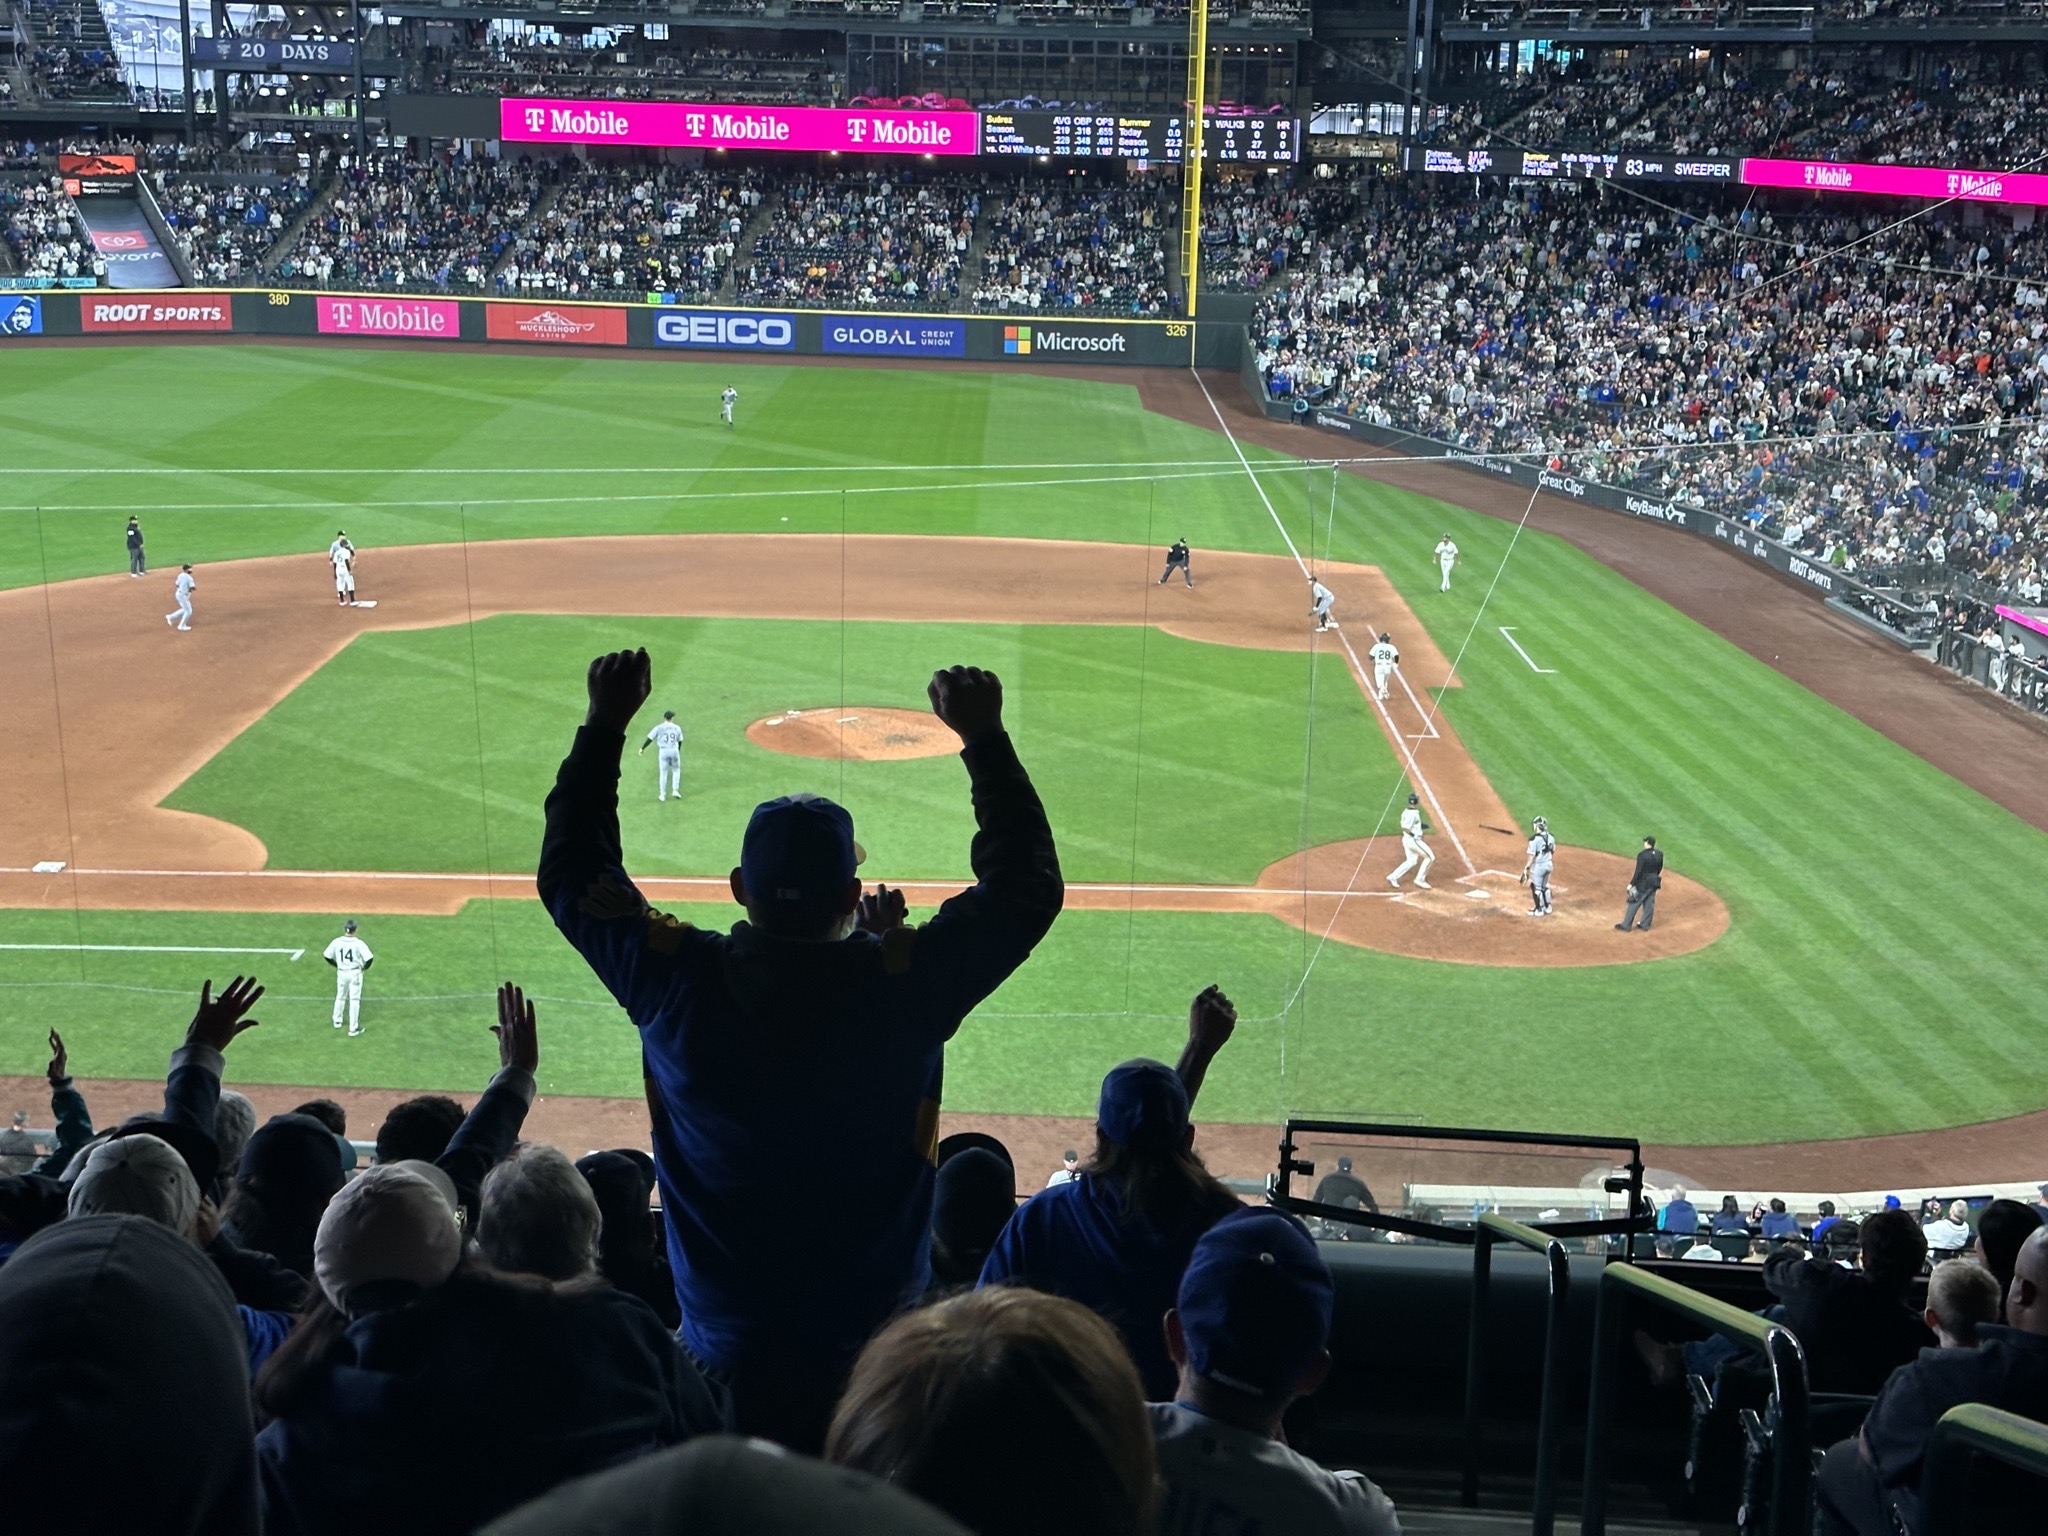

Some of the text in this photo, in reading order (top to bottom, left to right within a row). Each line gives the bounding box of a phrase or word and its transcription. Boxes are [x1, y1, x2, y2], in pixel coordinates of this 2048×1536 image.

[240, 43, 329, 60] 20 DAYS
[550, 109, 629, 135] Mobile
[711, 114, 789, 140] Mobile
[1053, 116, 1114, 126] AVG OBP OPS
[1170, 119, 1180, 128] IP
[1215, 120, 1245, 129] WALKS
[1251, 120, 1265, 129] SO
[1276, 121, 1291, 130] HR
[872, 119, 951, 145] Mobile
[986, 124, 1015, 133] Season
[1118, 128, 1287, 140] Today 0.0 0 0 0
[999, 135, 1024, 143] Lefties
[1118, 137, 1148, 146] Season
[1165, 138, 1183, 148] 22.2
[1224, 139, 1235, 149] 13
[1251, 140, 1263, 149] 27
[1279, 140, 1286, 150] 0
[998, 145, 1012, 153] Chi
[1012, 145, 1034, 154] White
[1035, 145, 1050, 154] Sox
[1053, 146, 1070, 155] .333
[1118, 147, 1133, 157] Per
[1133, 147, 1140, 157] 9
[1140, 148, 1150, 157] IP
[1246, 150, 1267, 160] 10.72
[1273, 150, 1292, 160] 0.00
[1561, 153, 1578, 162] Balls
[1579, 153, 1601, 163] Strikes
[1602, 154, 1618, 164] Total
[1585, 162, 1594, 171] 10
[1625, 159, 1730, 177] 83 MPH SWEEPER
[1815, 167, 1852, 187] Mobile
[1960, 175, 2002, 197] Mobile
[268, 293, 290, 306] 380
[94, 304, 222, 322] ROOT SPORTS
[359, 304, 445, 332] Mobile
[520, 324, 581, 334] MUCKLESHOOT
[657, 315, 792, 346] GEICO
[1166, 324, 1188, 337] 326
[833, 327, 954, 346] GLOBAL CREDIT
[921, 338, 951, 346] UNION
[1037, 332, 1126, 352] Microsoft
[1538, 471, 1584, 497] Great Clips
[1626, 496, 1664, 519] KeyBank
[1789, 556, 1832, 590] ROOT SPORTS
[1378, 650, 1391, 660] 28
[663, 733, 676, 743] 39
[339, 948, 354, 962] 14
